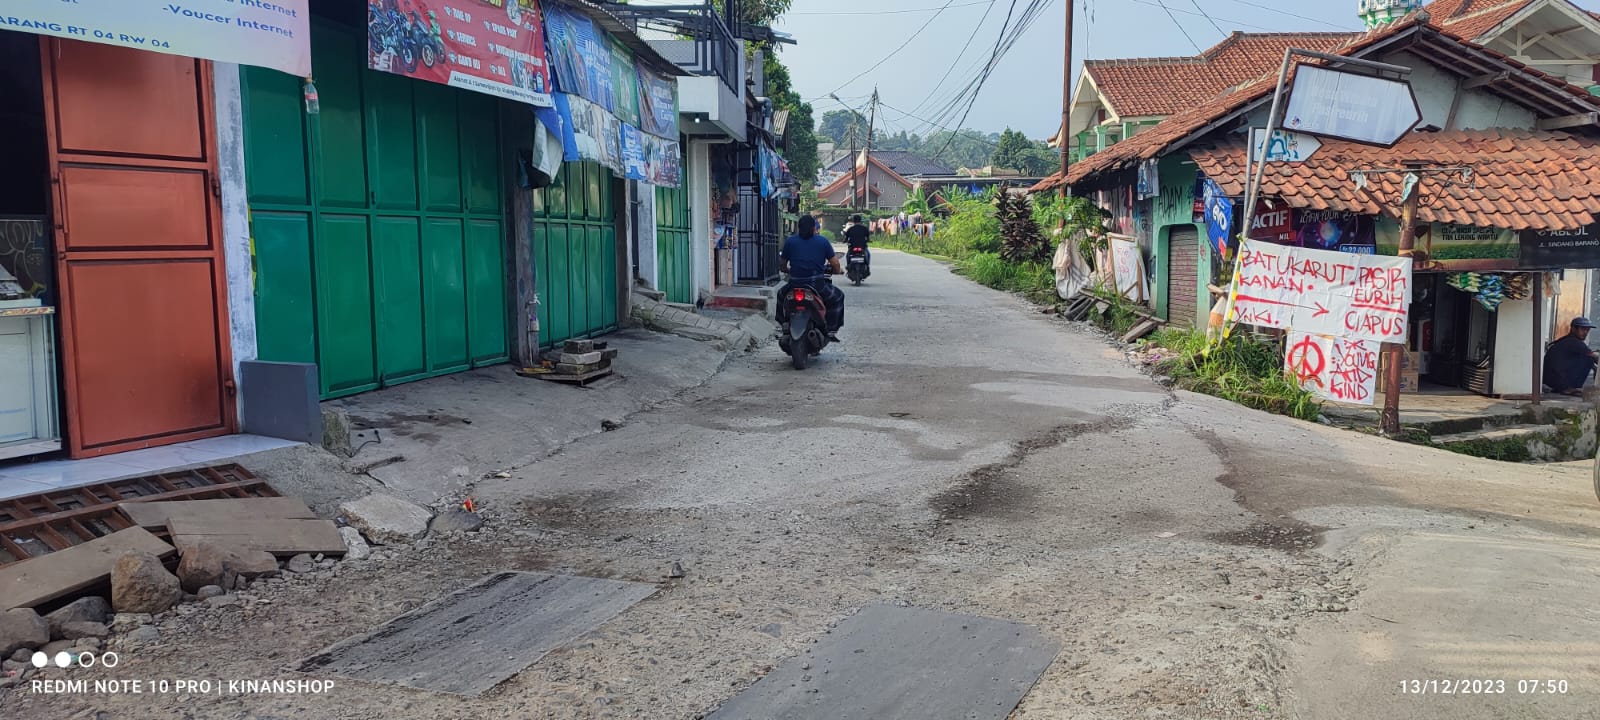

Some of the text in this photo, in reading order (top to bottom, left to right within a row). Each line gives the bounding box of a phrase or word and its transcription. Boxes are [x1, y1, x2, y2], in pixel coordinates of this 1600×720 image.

[67, 25, 88, 36] RT
[94, 29, 114, 40] 04
[120, 34, 146, 44] RW
[152, 39, 171, 49] 04
[237, 17, 295, 39] Internet
[1252, 210, 1289, 230] ACTIF
[1359, 266, 1407, 291] PASIR
[1354, 288, 1404, 307] EURIH
[1345, 311, 1404, 335] CIAPUS
[1331, 379, 1369, 400] KIND
